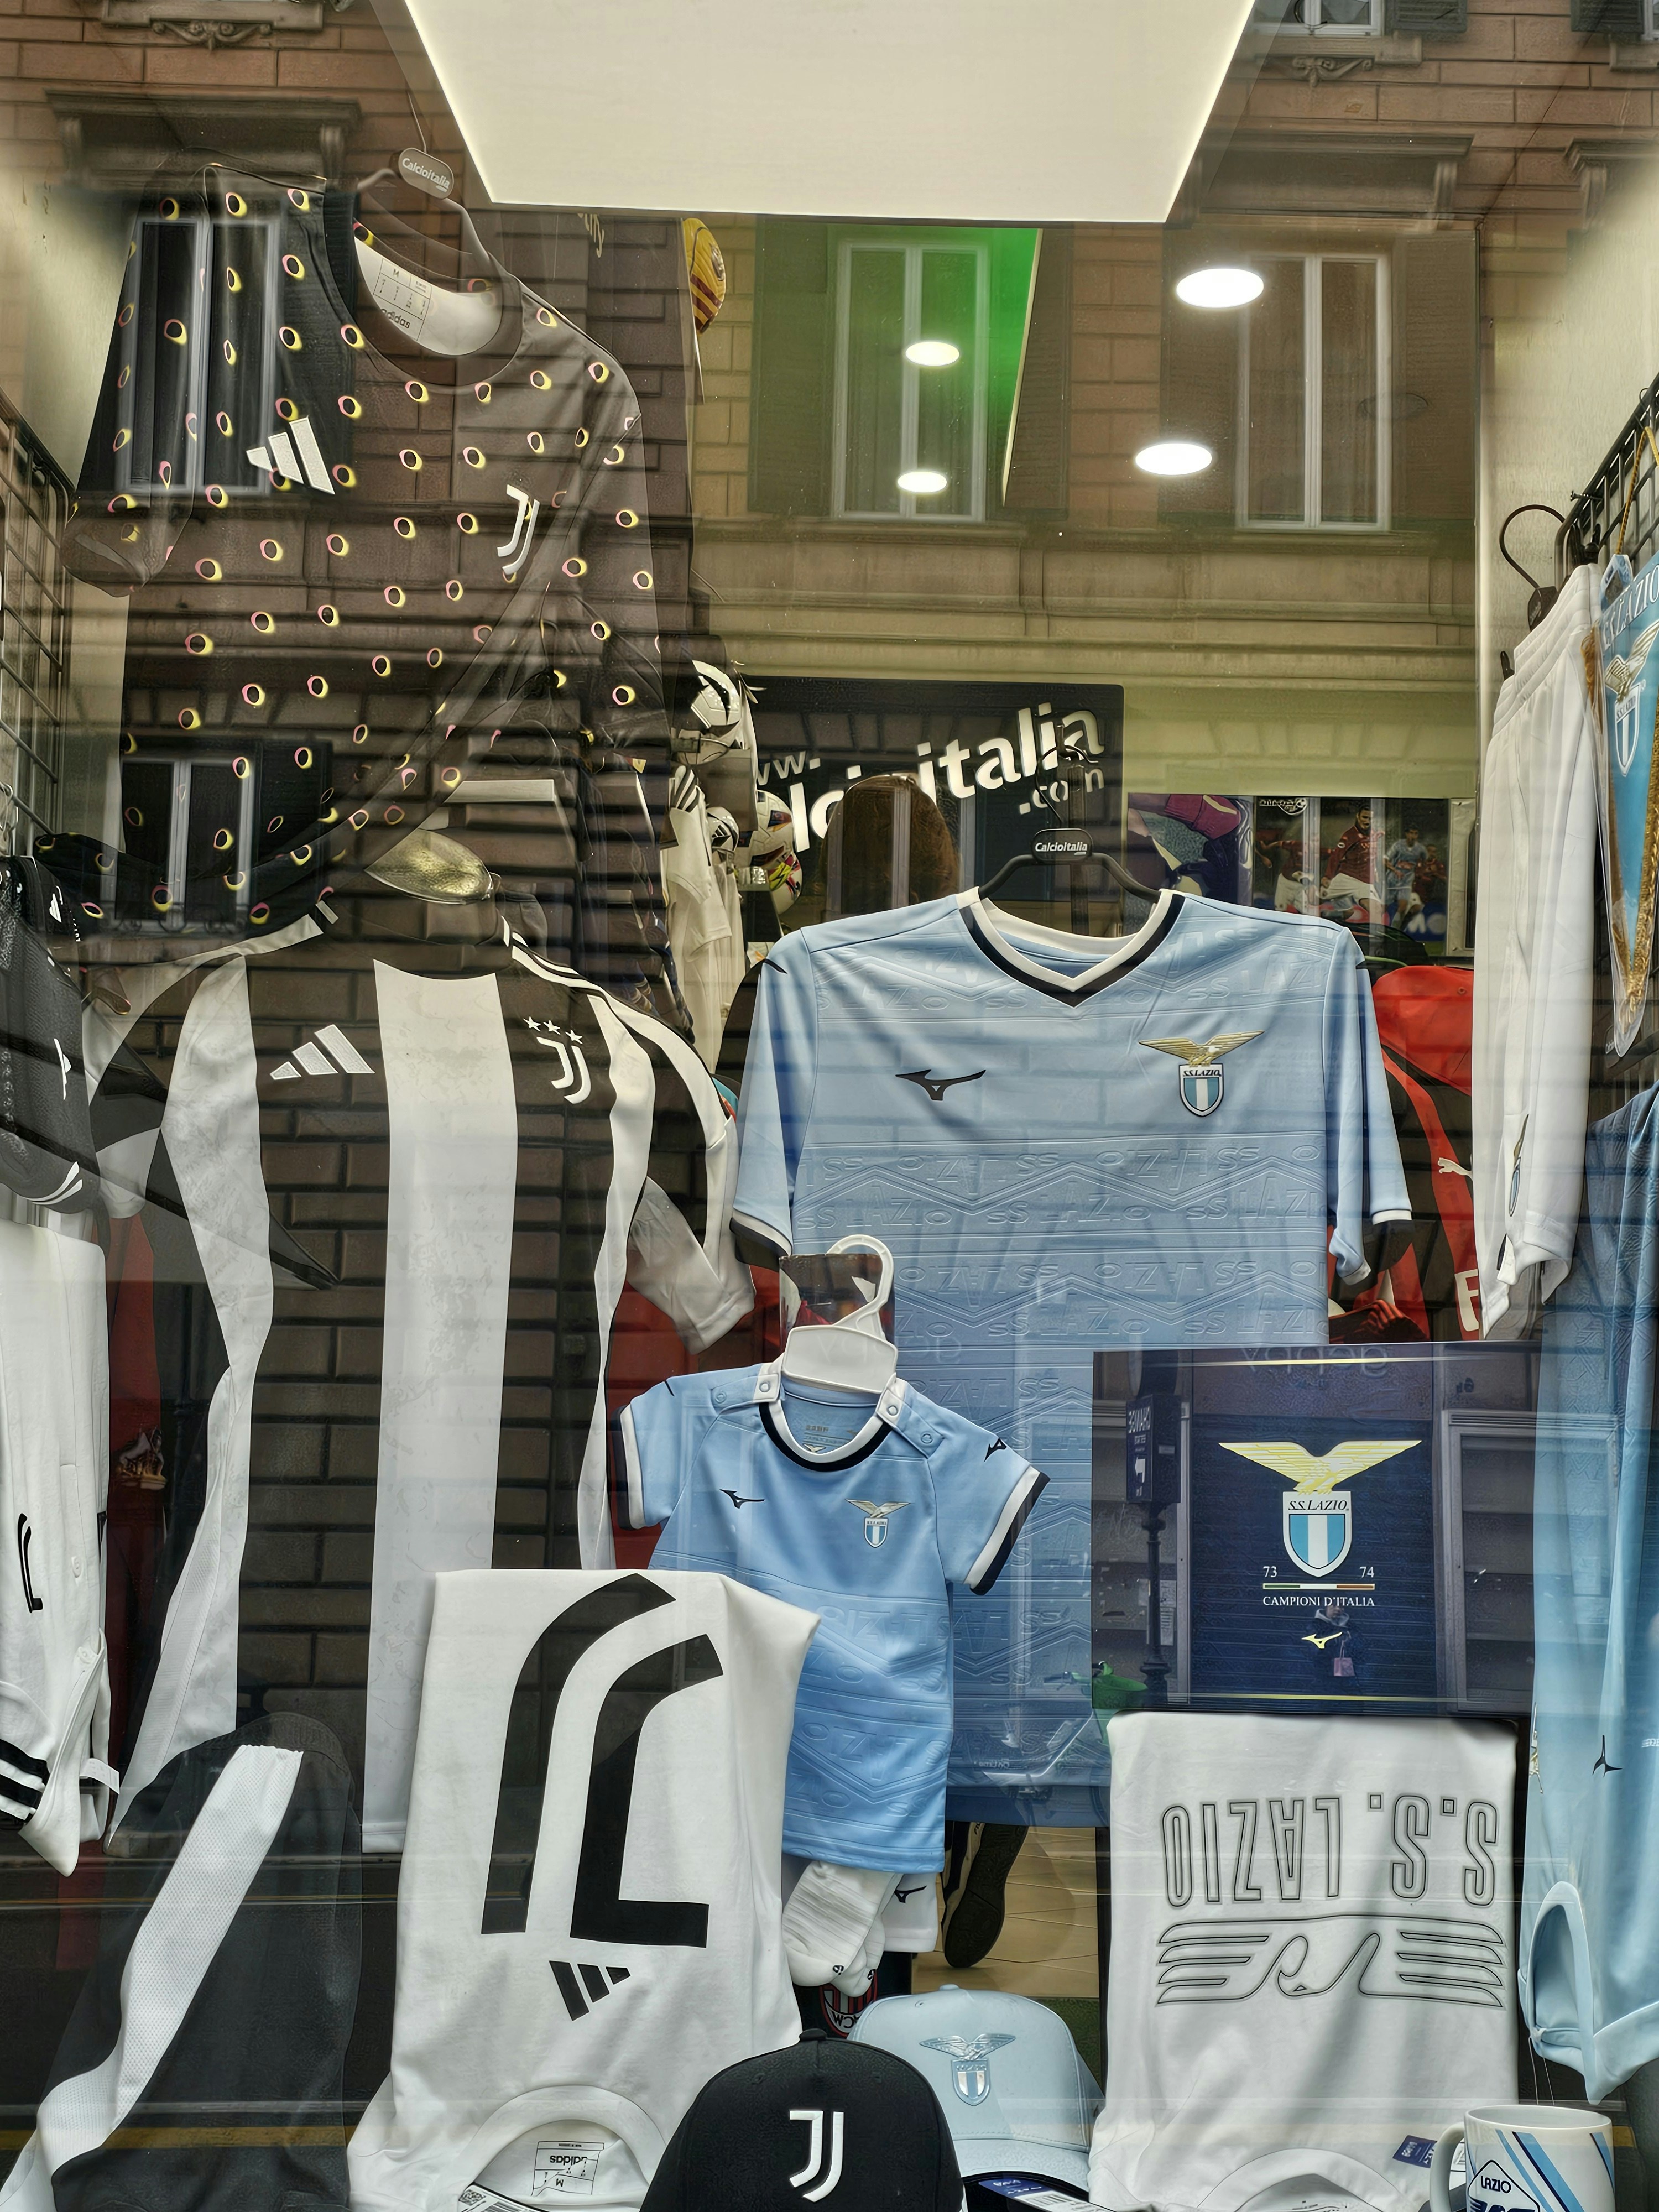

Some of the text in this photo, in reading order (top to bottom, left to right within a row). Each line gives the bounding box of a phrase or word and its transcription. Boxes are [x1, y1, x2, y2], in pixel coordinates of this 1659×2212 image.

[1262, 1566, 1375, 1578] 73 74
[1262, 1596, 1375, 1606] CAMPIONI D'ITALIA
[1161, 1796, 1344, 1909] LAZIO
[1480, 2175, 1511, 2194] LAZIO
